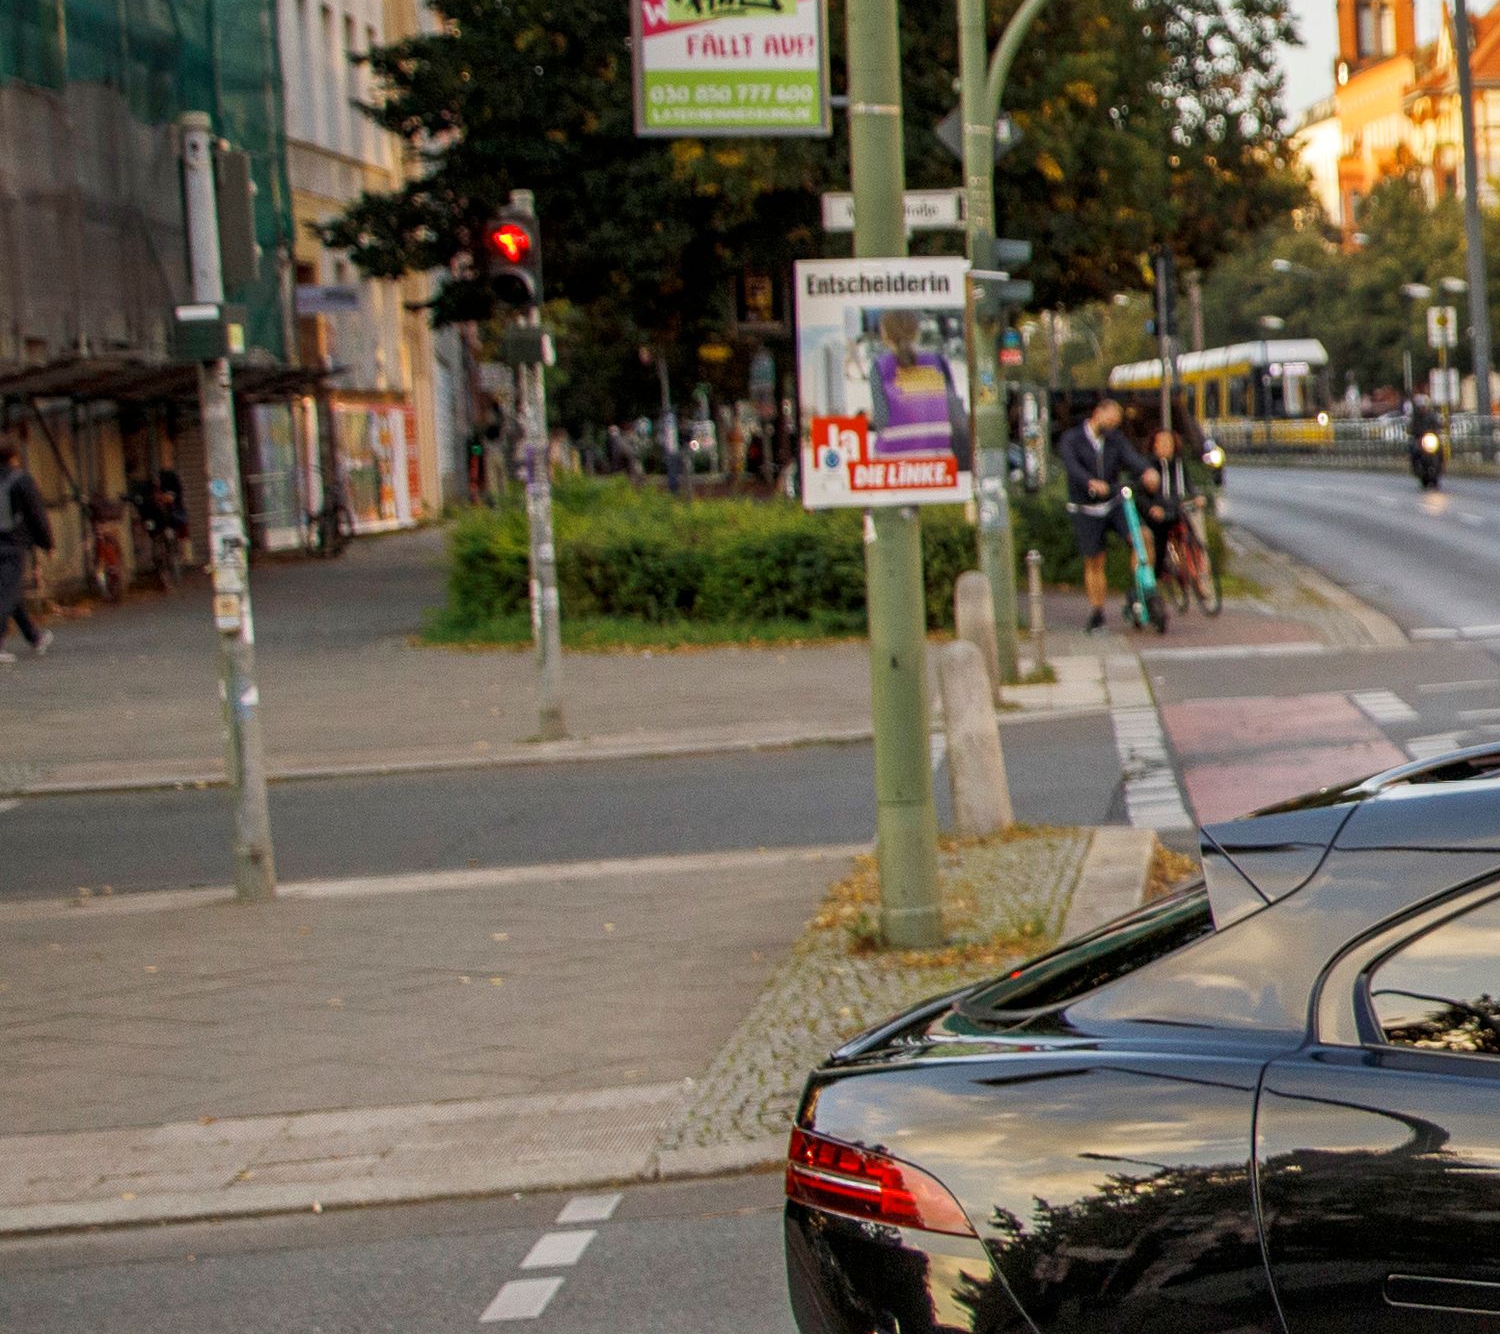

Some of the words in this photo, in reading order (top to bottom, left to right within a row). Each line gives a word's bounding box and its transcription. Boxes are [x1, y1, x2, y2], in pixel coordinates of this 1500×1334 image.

[764, 33, 815, 58] AUF!
[651, 84, 690, 105] 030
[737, 83, 772, 104] 777
[806, 271, 950, 296] Entscheiderin
[854, 463, 886, 488] DIE
